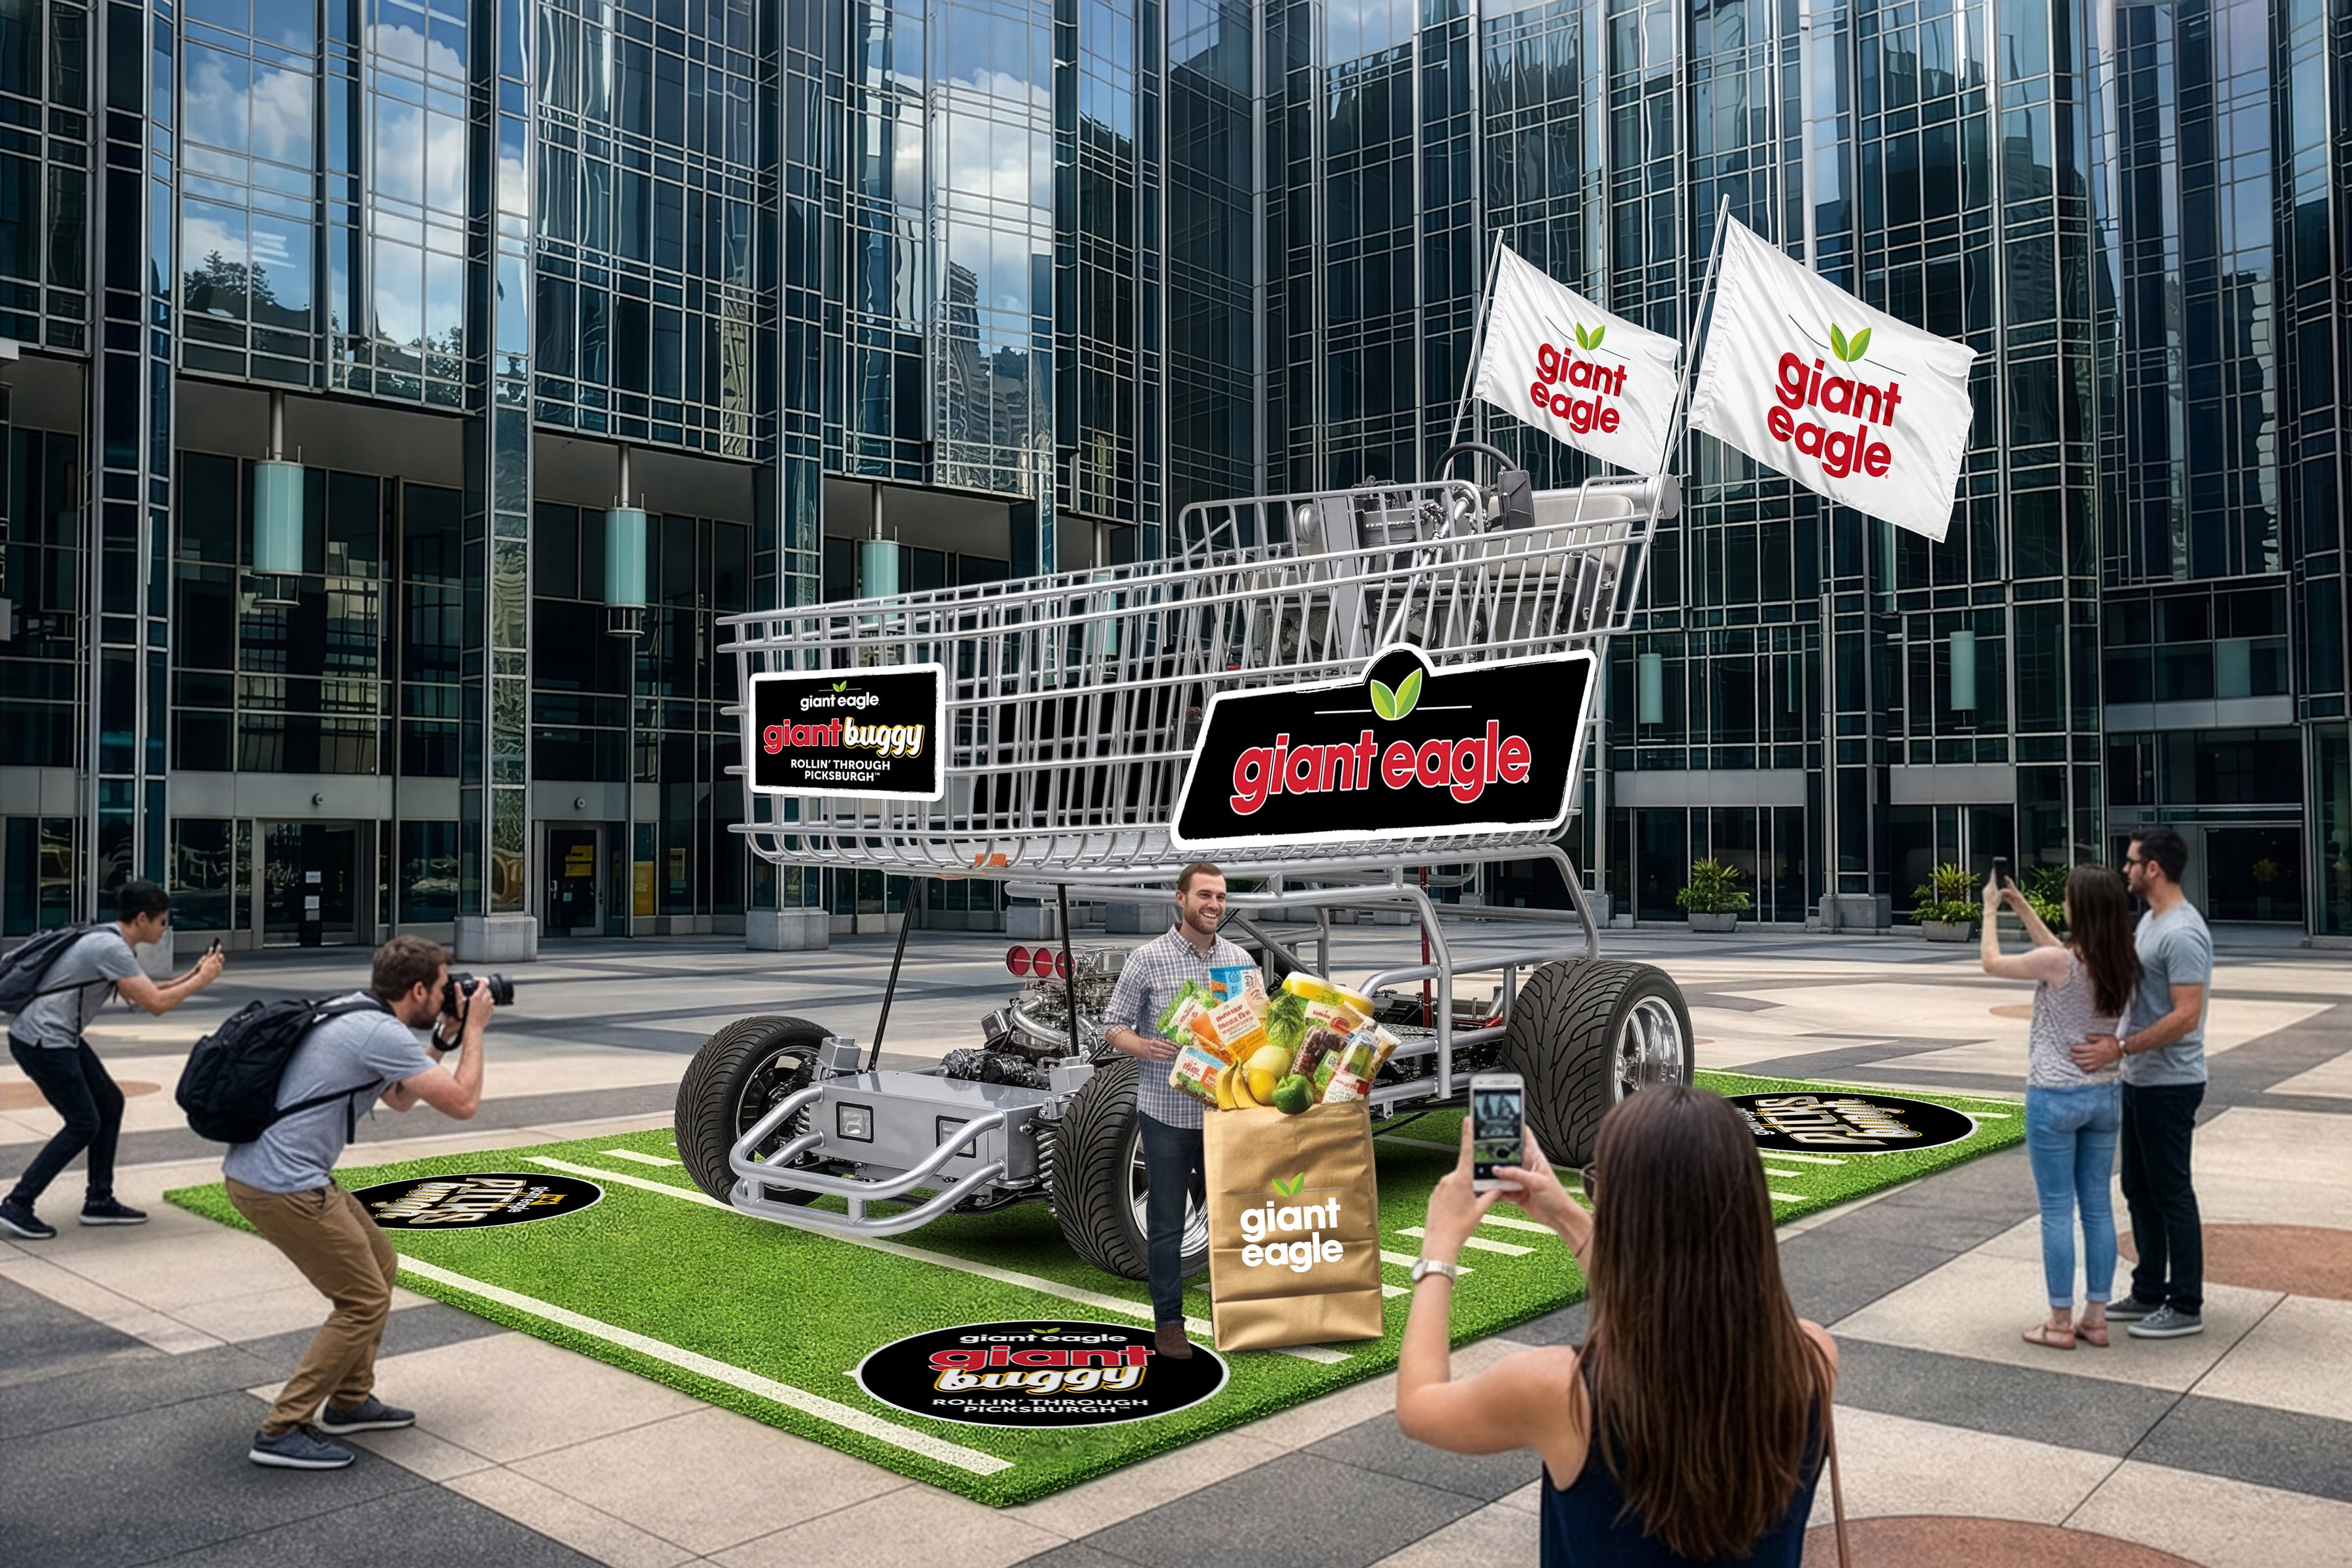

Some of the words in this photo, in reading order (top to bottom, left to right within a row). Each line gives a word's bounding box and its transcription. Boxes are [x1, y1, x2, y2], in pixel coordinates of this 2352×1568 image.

[1536, 343, 1627, 397] giant
[1775, 352, 1902, 427] giant
[1530, 382, 1620, 434] eagle
[1767, 406, 1891, 478] eagle
[800, 694, 836, 711] giant
[837, 692, 879, 710] eagle
[763, 718, 842, 754] giant
[843, 717, 925, 759] buggy
[833, 760, 890, 770] THROUGH
[1230, 730, 1377, 815] giant
[1382, 719, 1531, 804] eagle
[1755, 1096, 1888, 1145] PICKS
[408, 1177, 527, 1224] PICKS
[507, 1198, 534, 1213] eagle
[523, 1186, 550, 1198] giant
[1240, 1197, 1341, 1243] giant
[1241, 1232, 1344, 1273] eagle
[928, 1345, 1156, 1371] giant
[959, 1333, 1037, 1343] giant
[1041, 1333, 1128, 1343] eagle
[934, 1365, 1148, 1395] buggy
